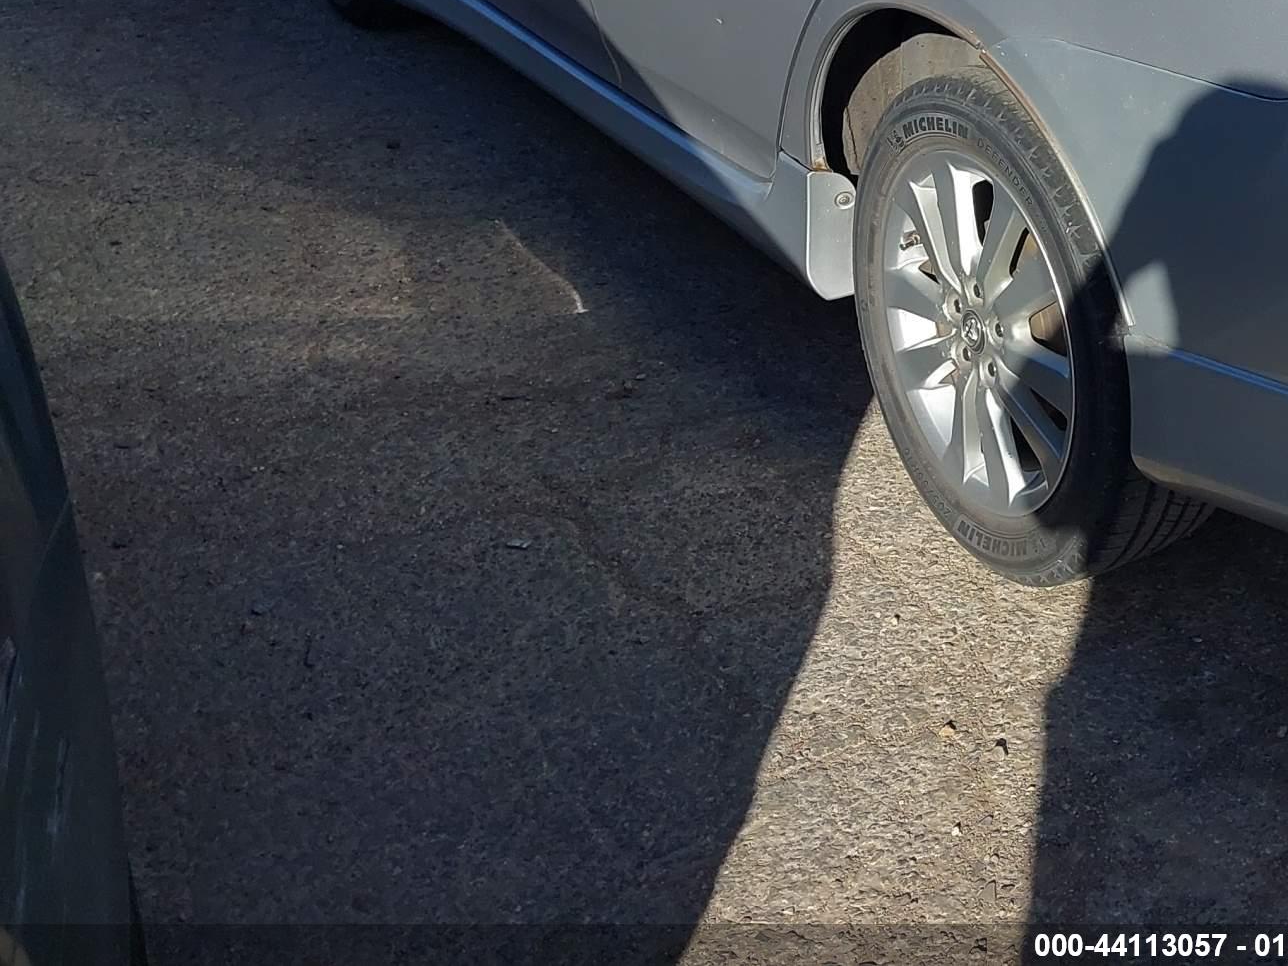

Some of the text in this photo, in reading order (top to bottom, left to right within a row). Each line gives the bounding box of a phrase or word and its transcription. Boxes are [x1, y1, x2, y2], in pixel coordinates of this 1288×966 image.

[902, 116, 969, 139] MICHELIN
[977, 137, 1033, 206] DEFENDER
[956, 520, 1028, 557] MICHELIN
